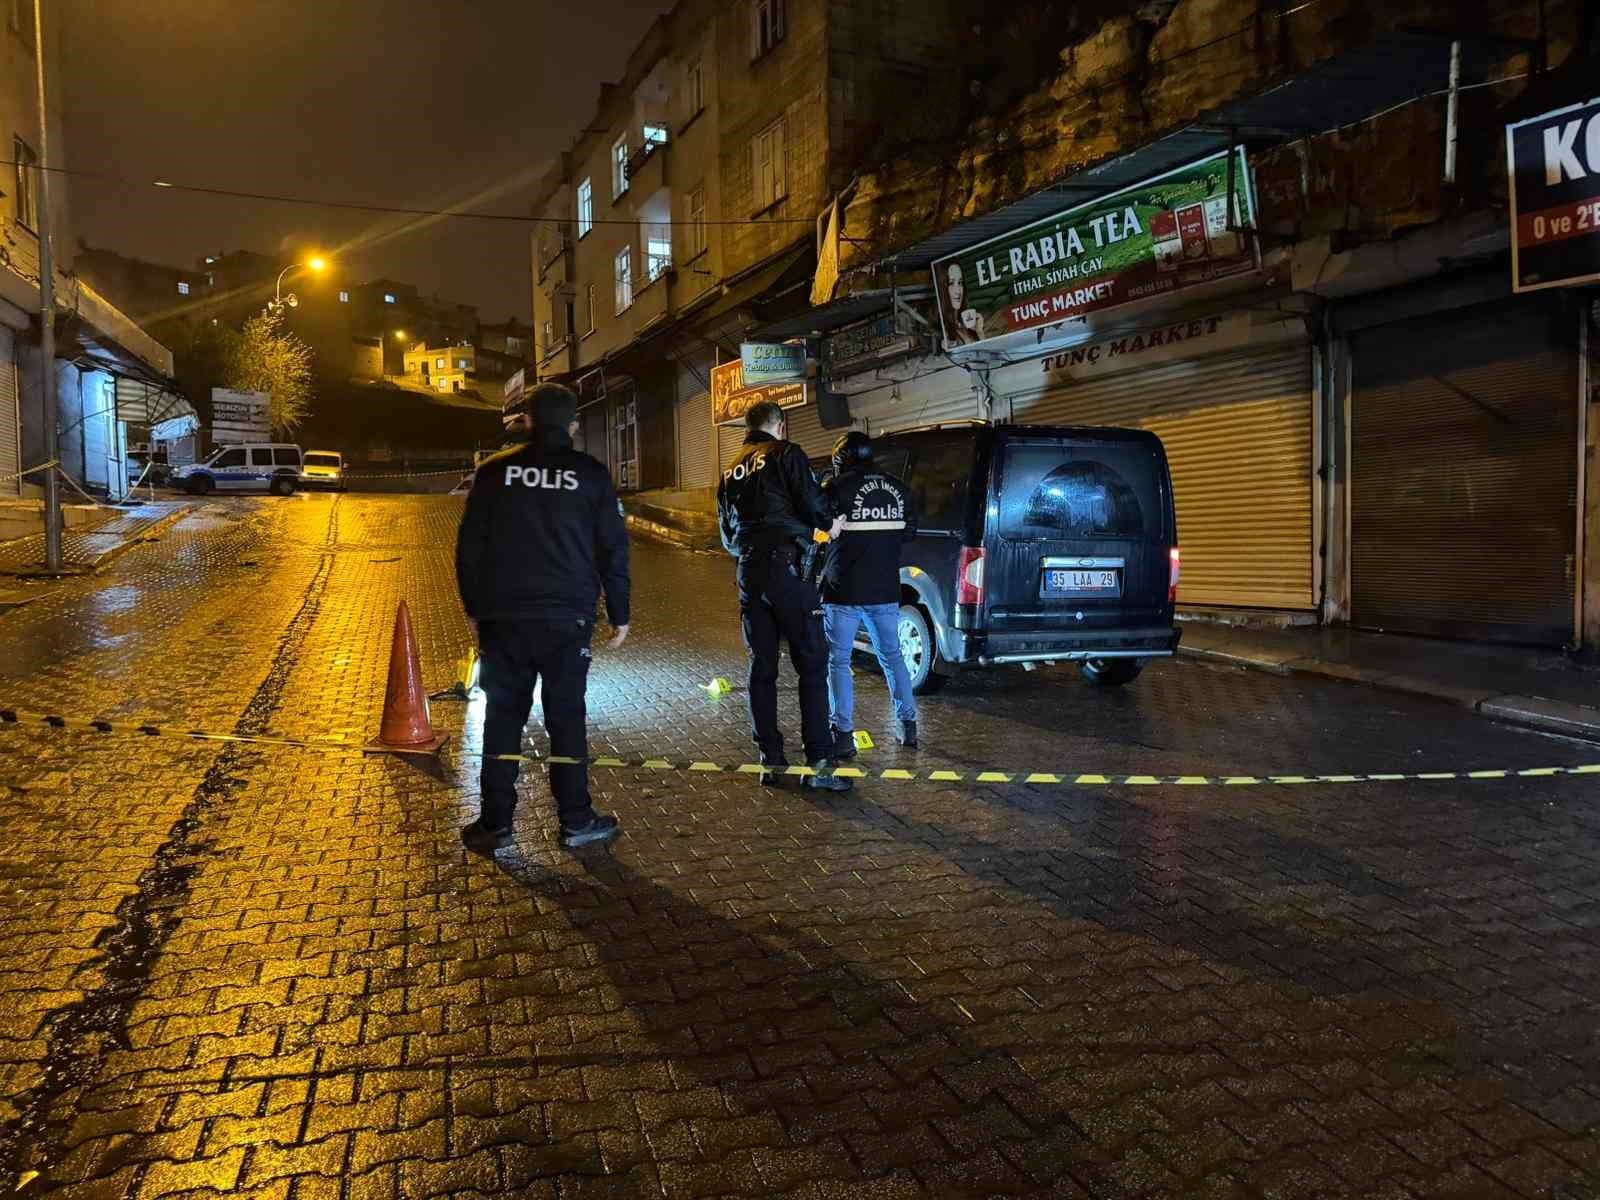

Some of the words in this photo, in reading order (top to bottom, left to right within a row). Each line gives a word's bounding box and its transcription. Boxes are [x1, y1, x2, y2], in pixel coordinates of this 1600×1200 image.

[1550, 215, 1571, 235] ve
[975, 223, 1085, 287] EL-RABİA
[1088, 206, 1144, 248] TEA
[1080, 255, 1104, 277] ÇAY
[1010, 300, 1051, 323] TUNÇ
[1053, 280, 1115, 312] MARKET
[1041, 345, 1101, 373] TUNÇ
[1108, 316, 1223, 357] MARKET
[1053, 573, 1065, 585] 35
[1074, 573, 1092, 586] LAA
